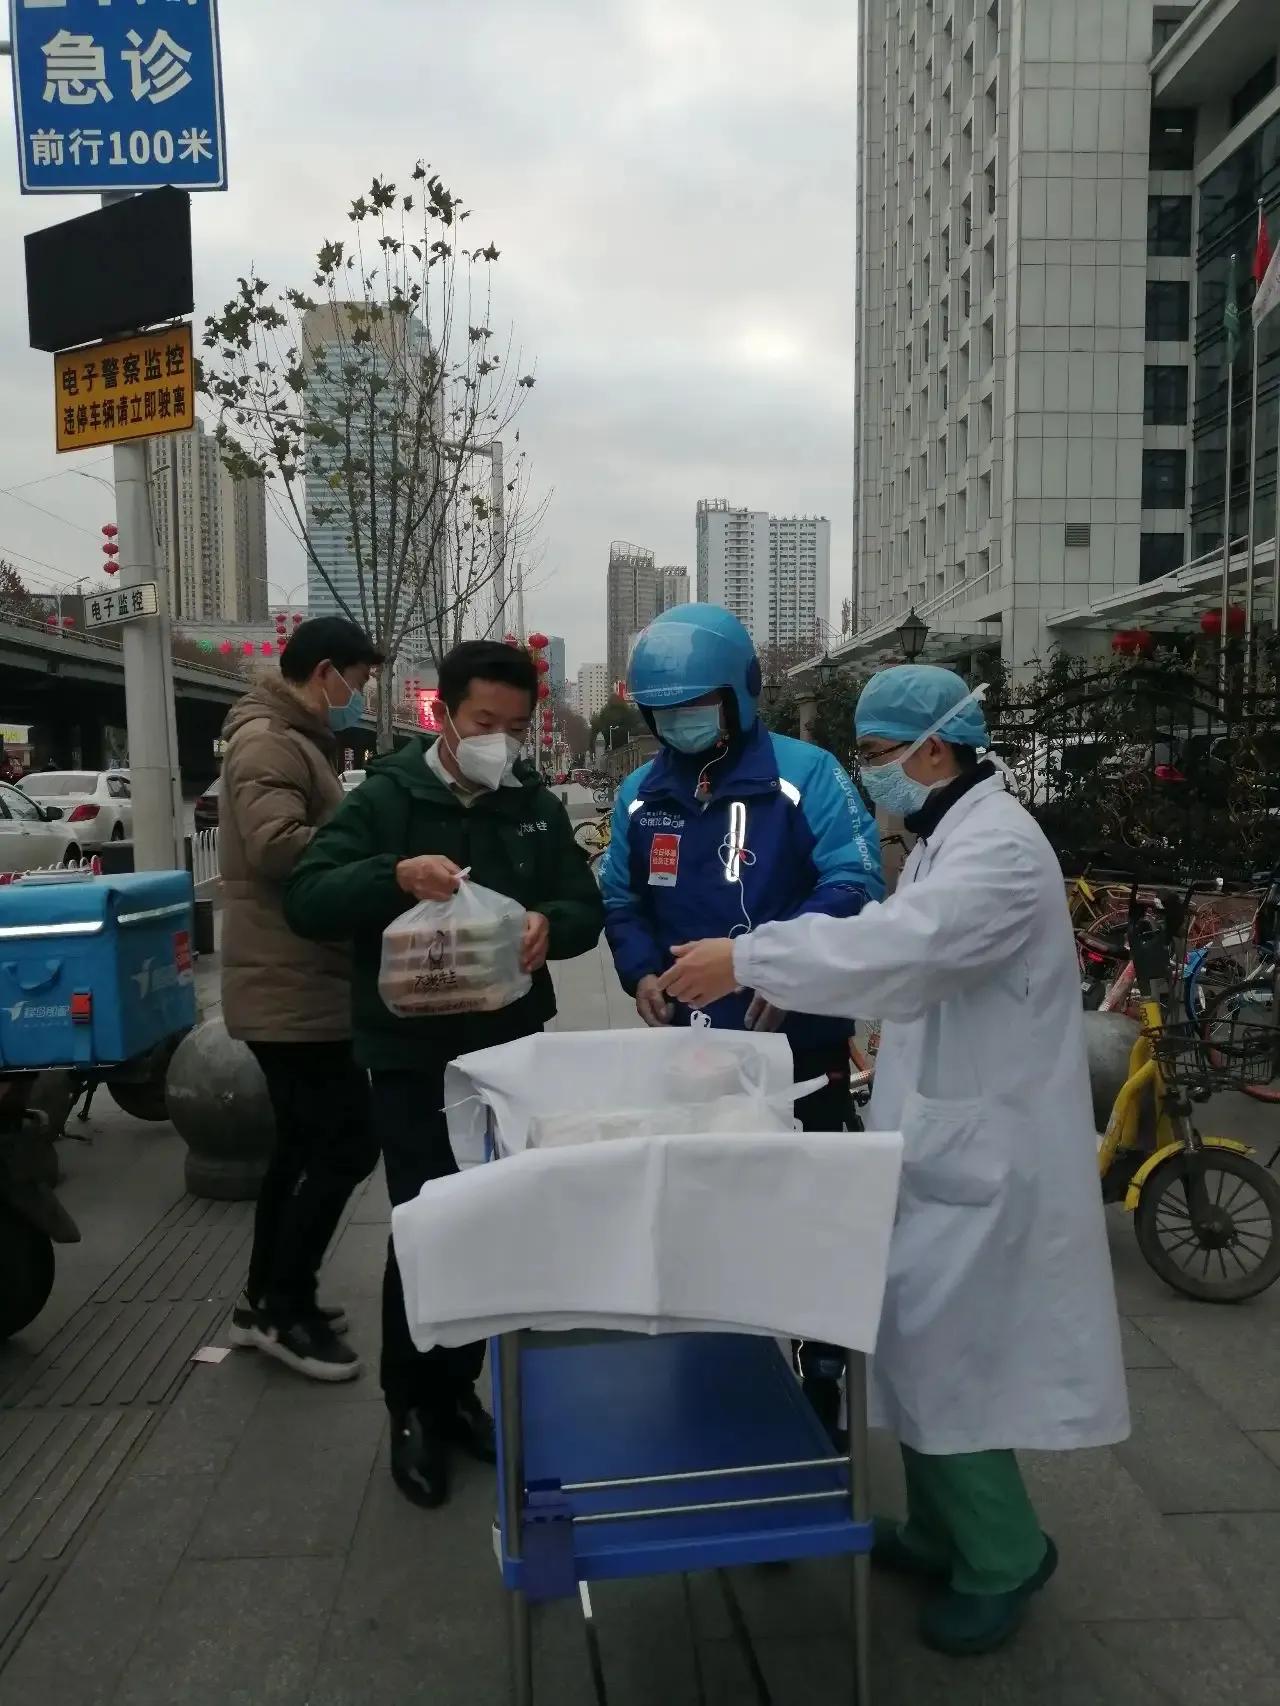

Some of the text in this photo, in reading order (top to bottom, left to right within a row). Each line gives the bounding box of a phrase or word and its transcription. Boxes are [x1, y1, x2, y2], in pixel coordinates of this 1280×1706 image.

[41, 28, 193, 104] 急诊
[30, 127, 213, 166] 前行100米
[62, 344, 185, 396] 电子警察监控
[63, 384, 186, 435] 违停车辆请立即驶离
[90, 589, 145, 621] 电子监控
[832, 767, 859, 816] DELIVER
